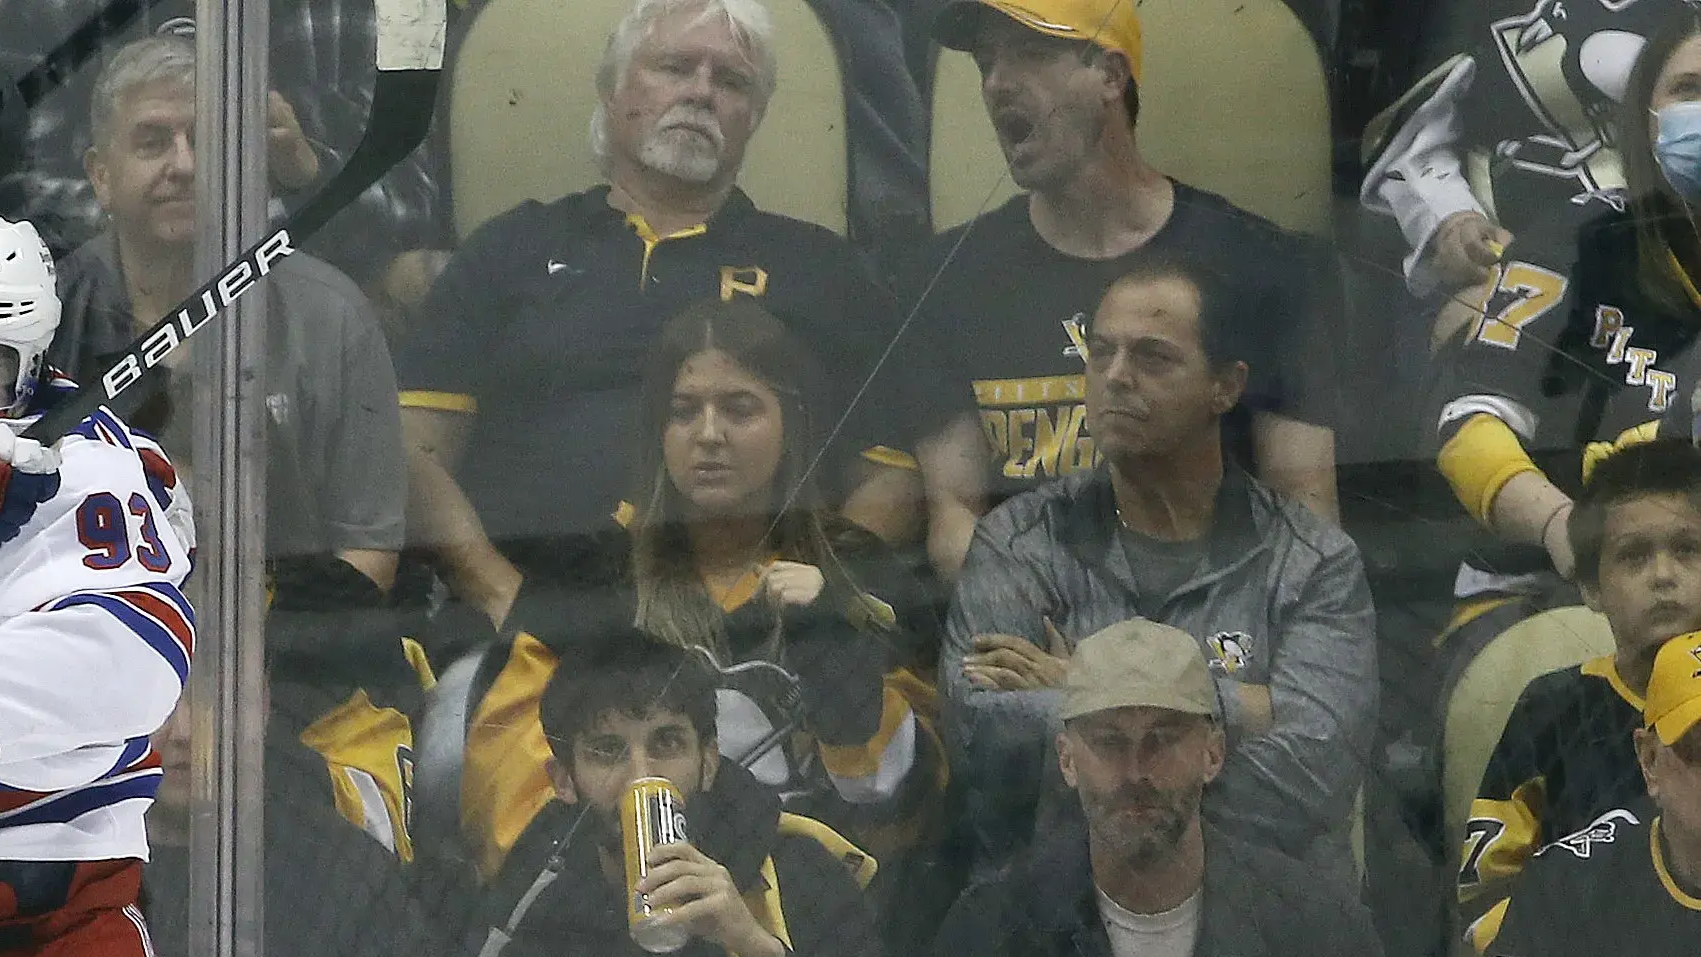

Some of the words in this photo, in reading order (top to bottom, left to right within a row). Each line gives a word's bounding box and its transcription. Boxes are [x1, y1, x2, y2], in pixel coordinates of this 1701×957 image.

[720, 265, 769, 302] P
[1464, 261, 1568, 351] 7
[75, 492, 173, 574] 93
